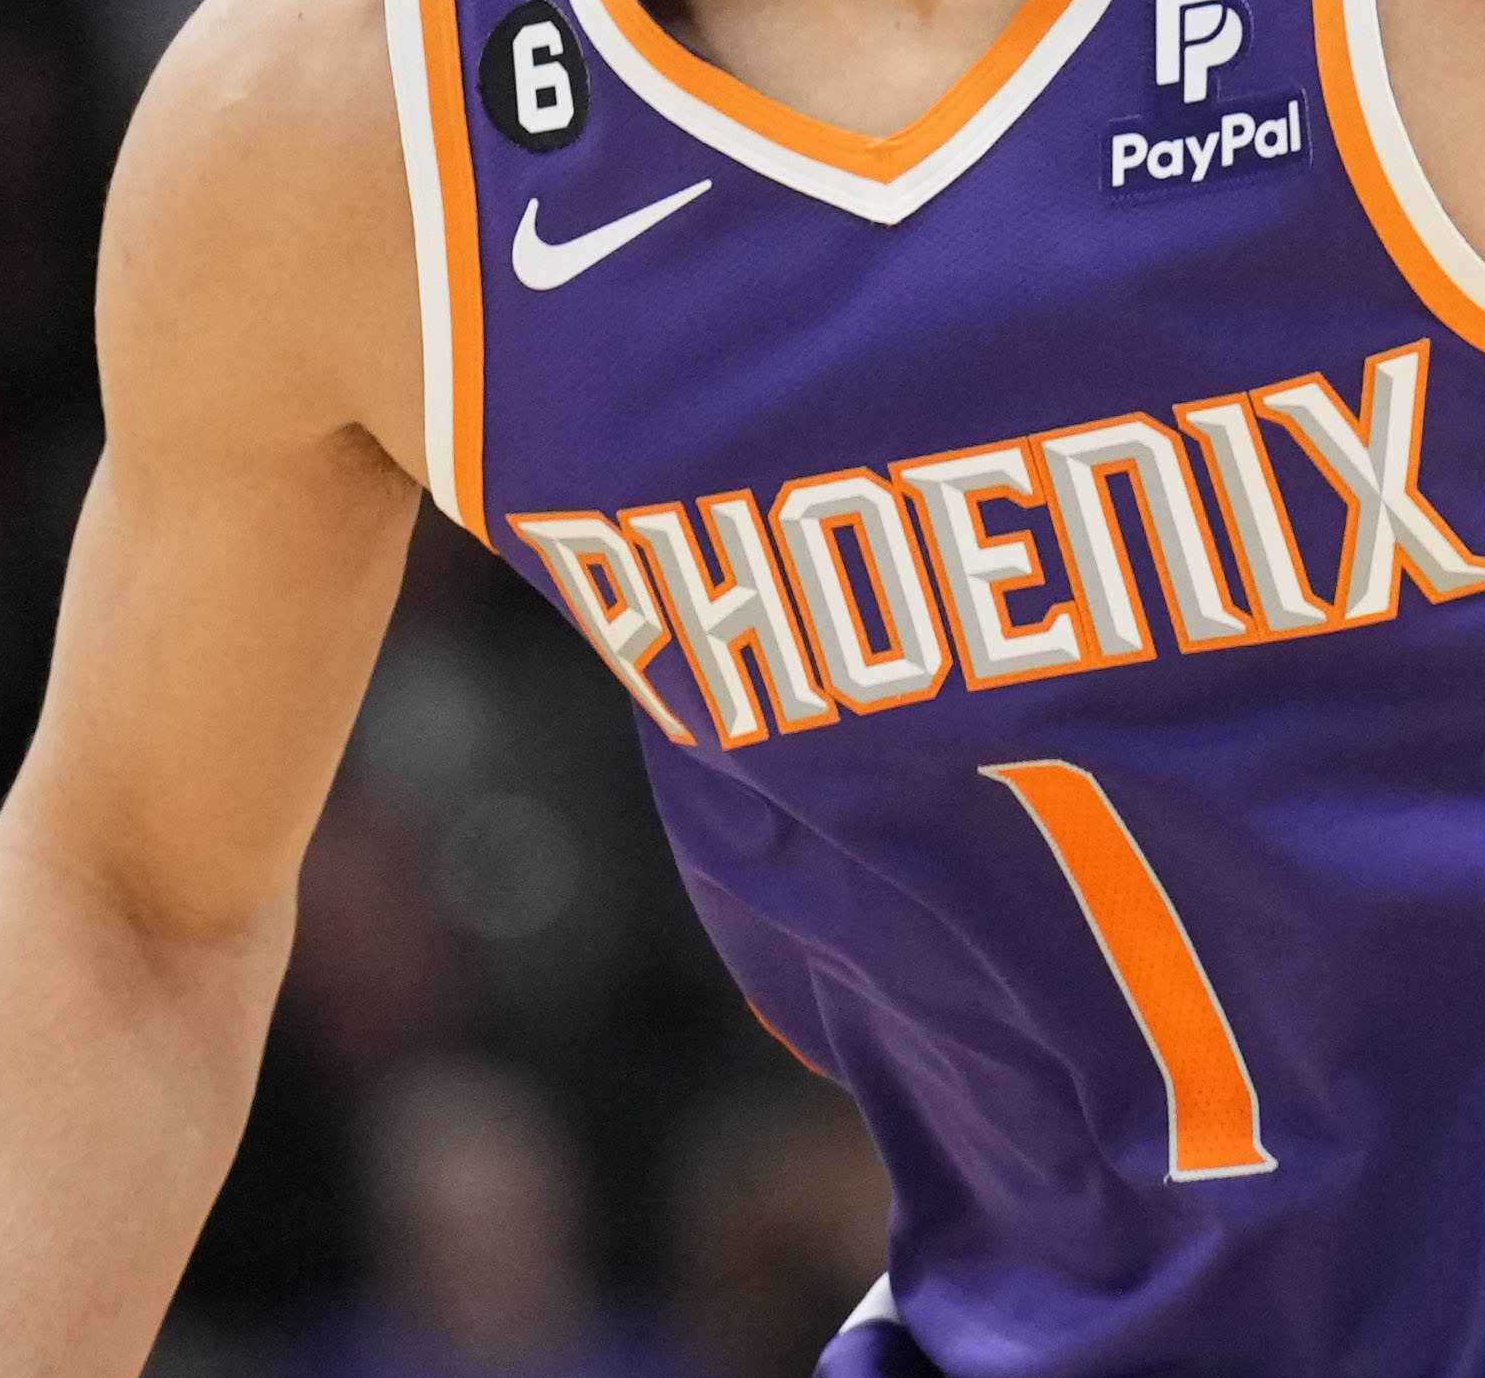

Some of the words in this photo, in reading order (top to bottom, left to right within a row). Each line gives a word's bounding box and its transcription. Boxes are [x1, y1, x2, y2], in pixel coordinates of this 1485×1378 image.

[512, 20, 575, 134] 6
[1111, 99, 1302, 188] PayPal
[979, 759, 1278, 1182] 1
